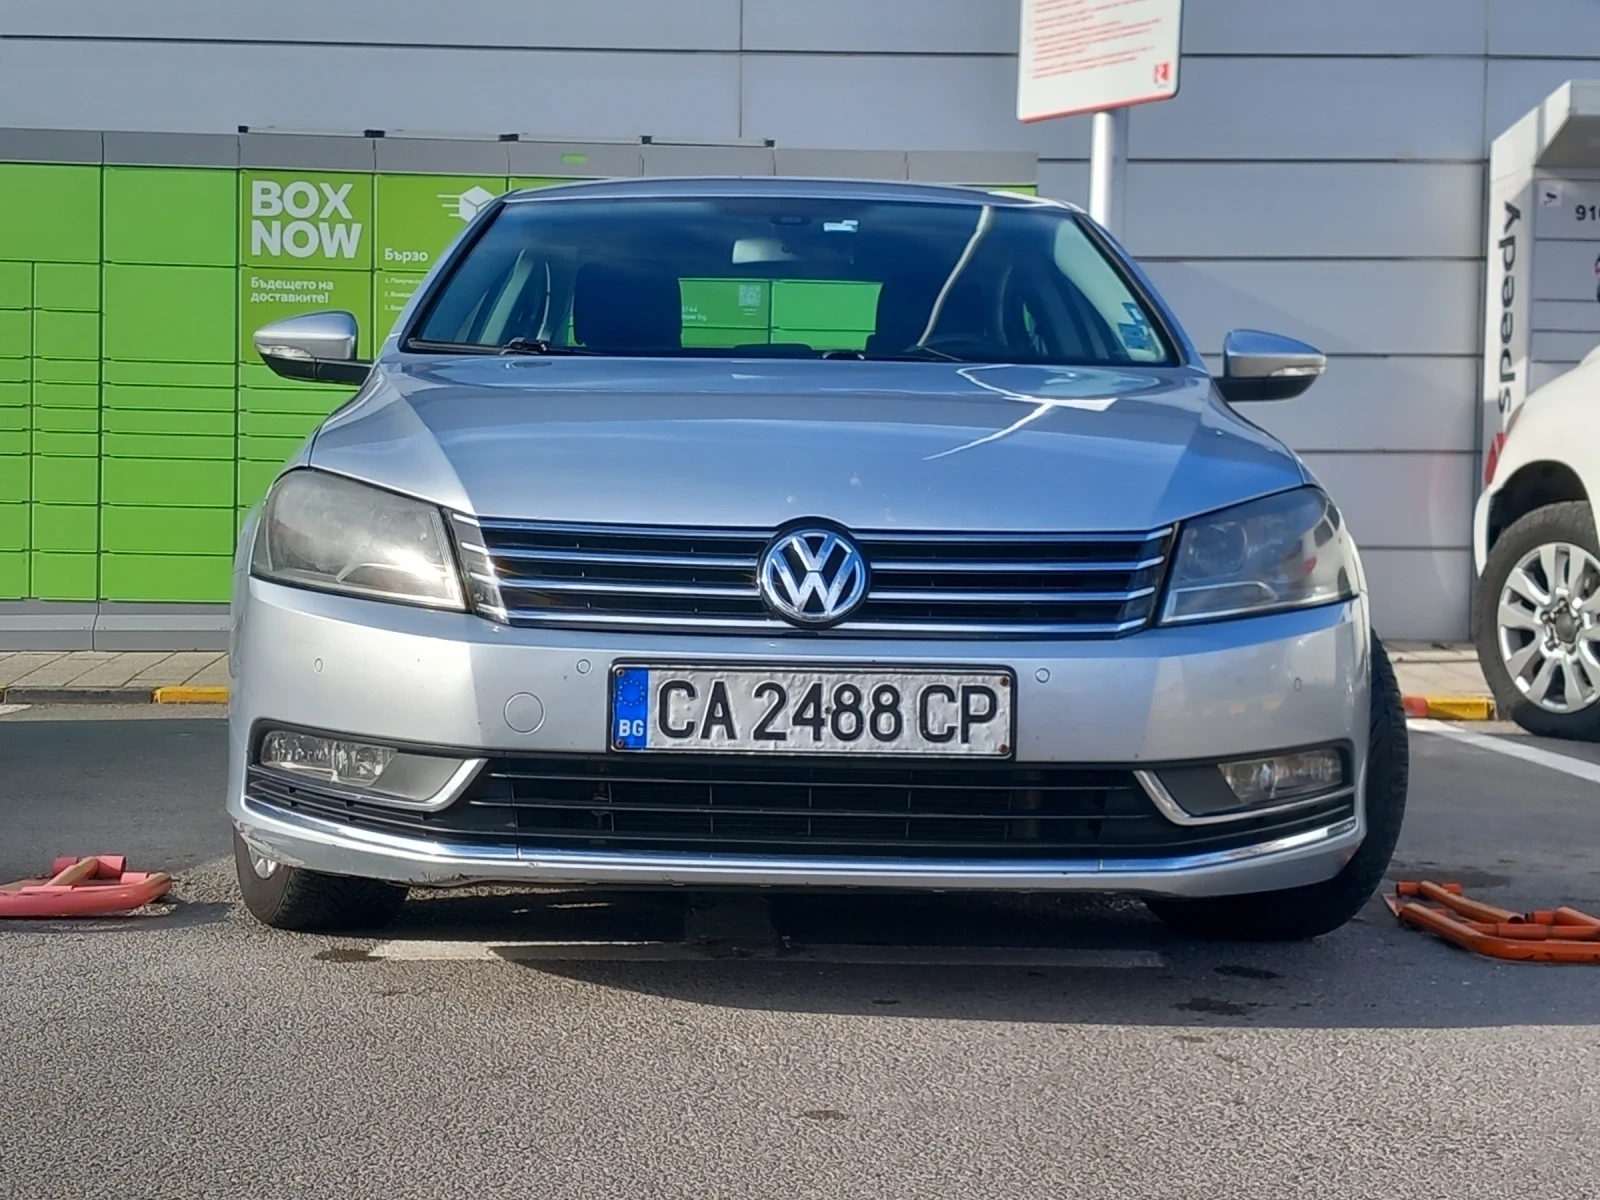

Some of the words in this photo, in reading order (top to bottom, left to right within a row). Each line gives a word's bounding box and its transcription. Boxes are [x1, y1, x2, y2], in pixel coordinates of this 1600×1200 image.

[252, 180, 353, 219] BOX
[1575, 204, 1600, 221] 91
[252, 220, 362, 258] NOW
[384, 247, 429, 264] Бързо
[251, 277, 317, 290] Бъдещето
[318, 281, 334, 291] на
[250, 292, 329, 304] доставките!
[1498, 202, 1521, 413] speedy
[657, 679, 739, 741] CA
[751, 681, 902, 743] 2488
[918, 683, 998, 745] CP
[619, 719, 645, 737] BG
